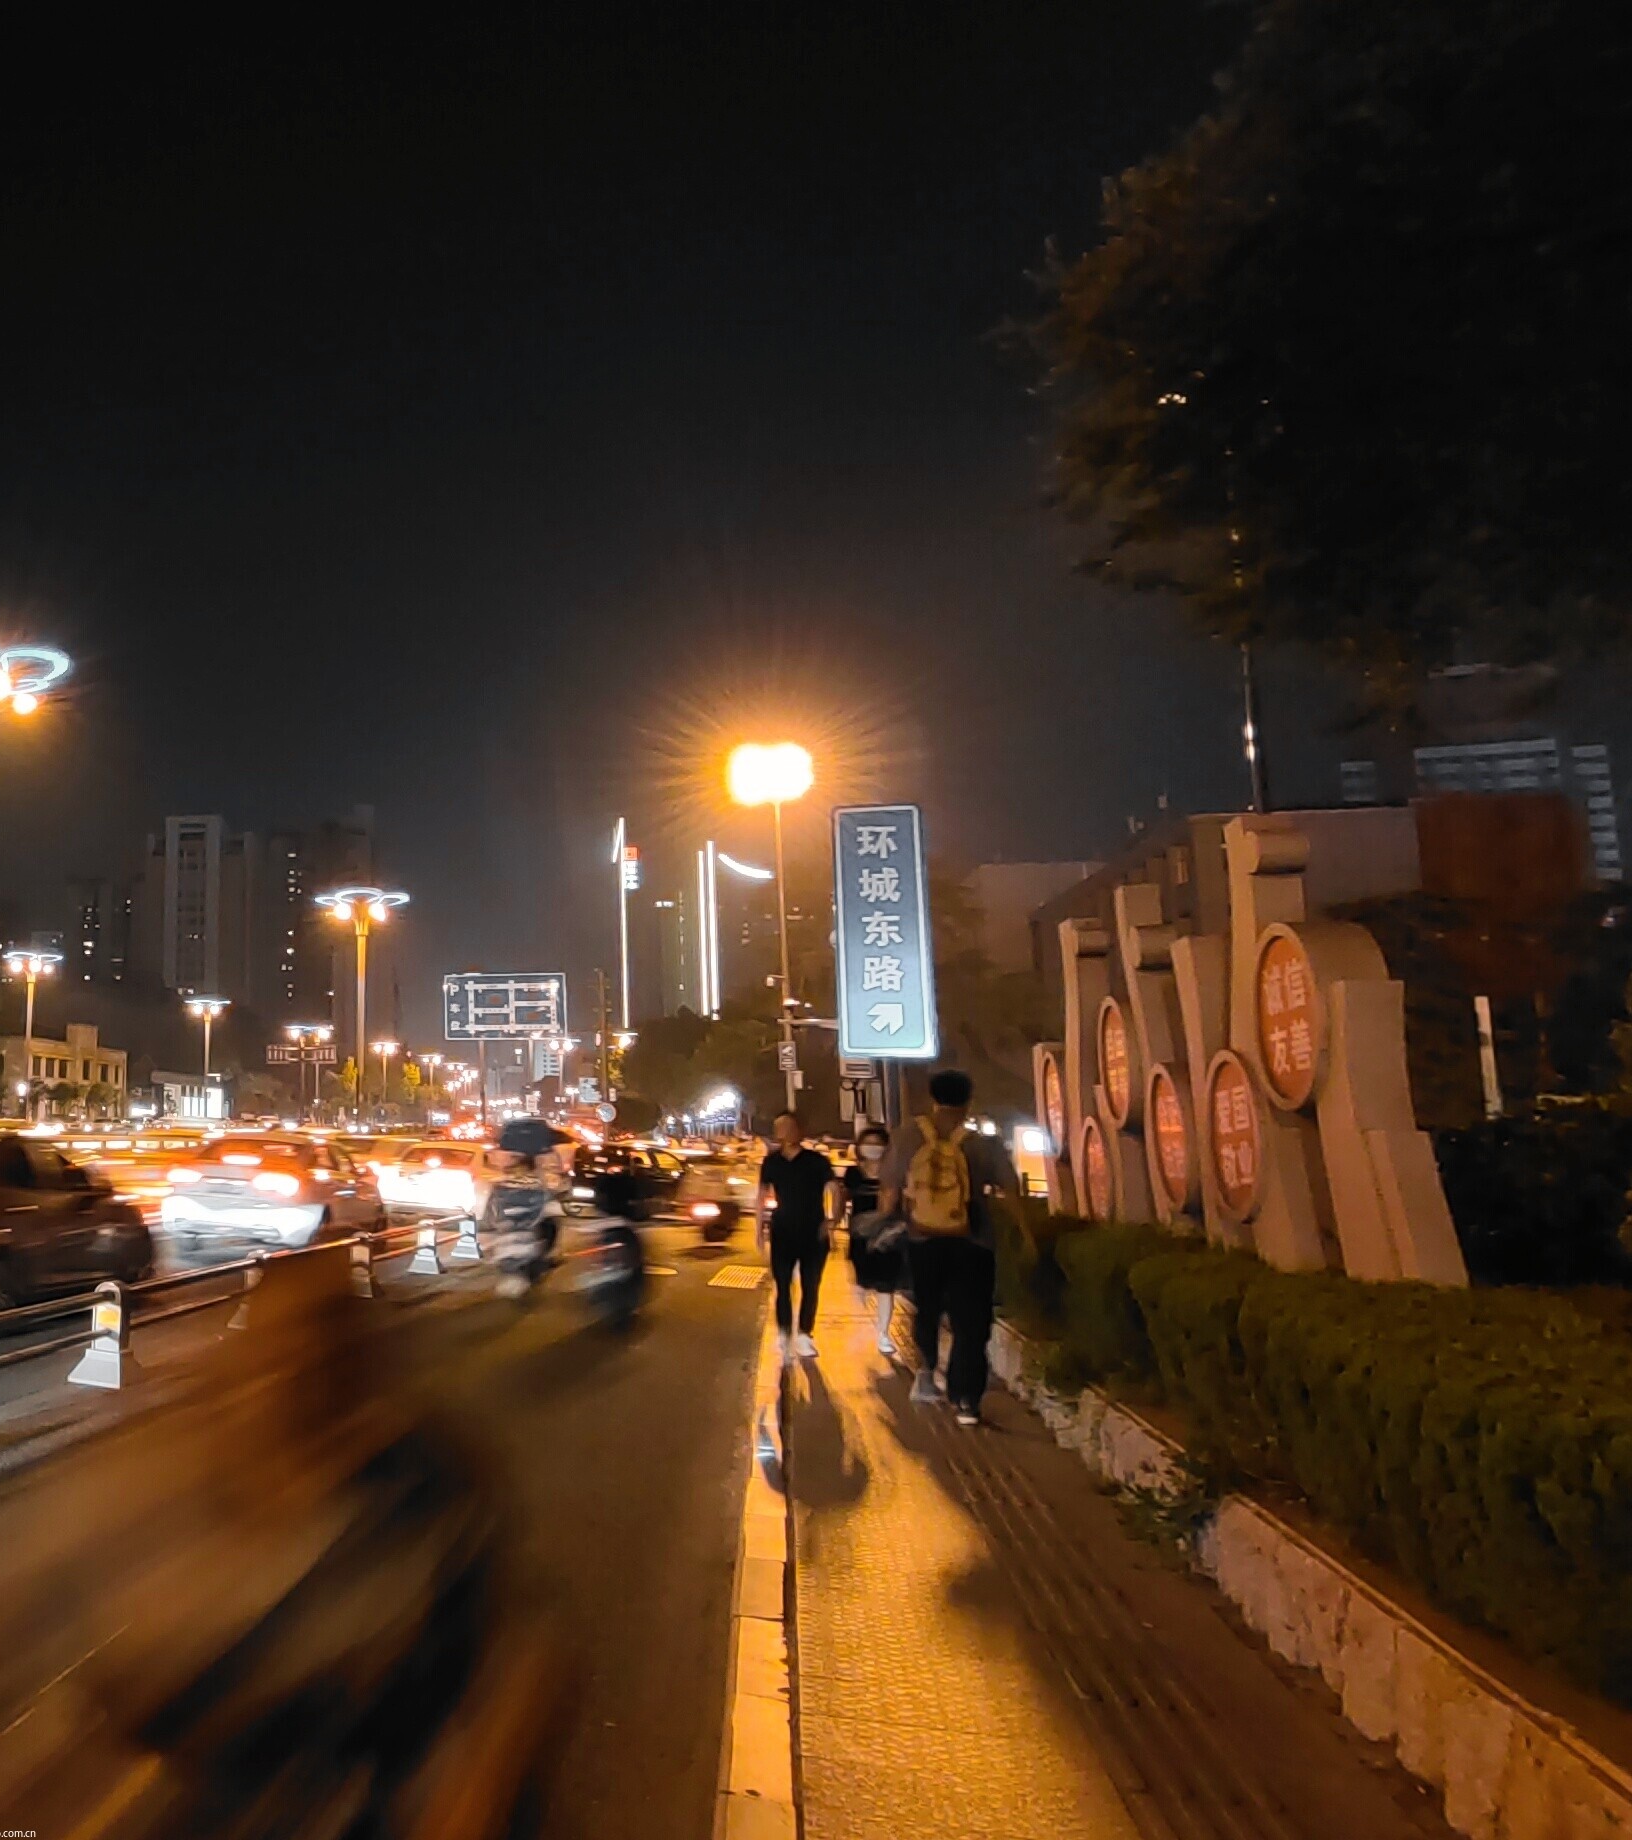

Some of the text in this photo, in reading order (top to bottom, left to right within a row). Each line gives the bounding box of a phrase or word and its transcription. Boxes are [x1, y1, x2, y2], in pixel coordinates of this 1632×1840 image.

[856, 825, 905, 992] 环城东路
[1269, 1018, 1313, 1075] 友善
